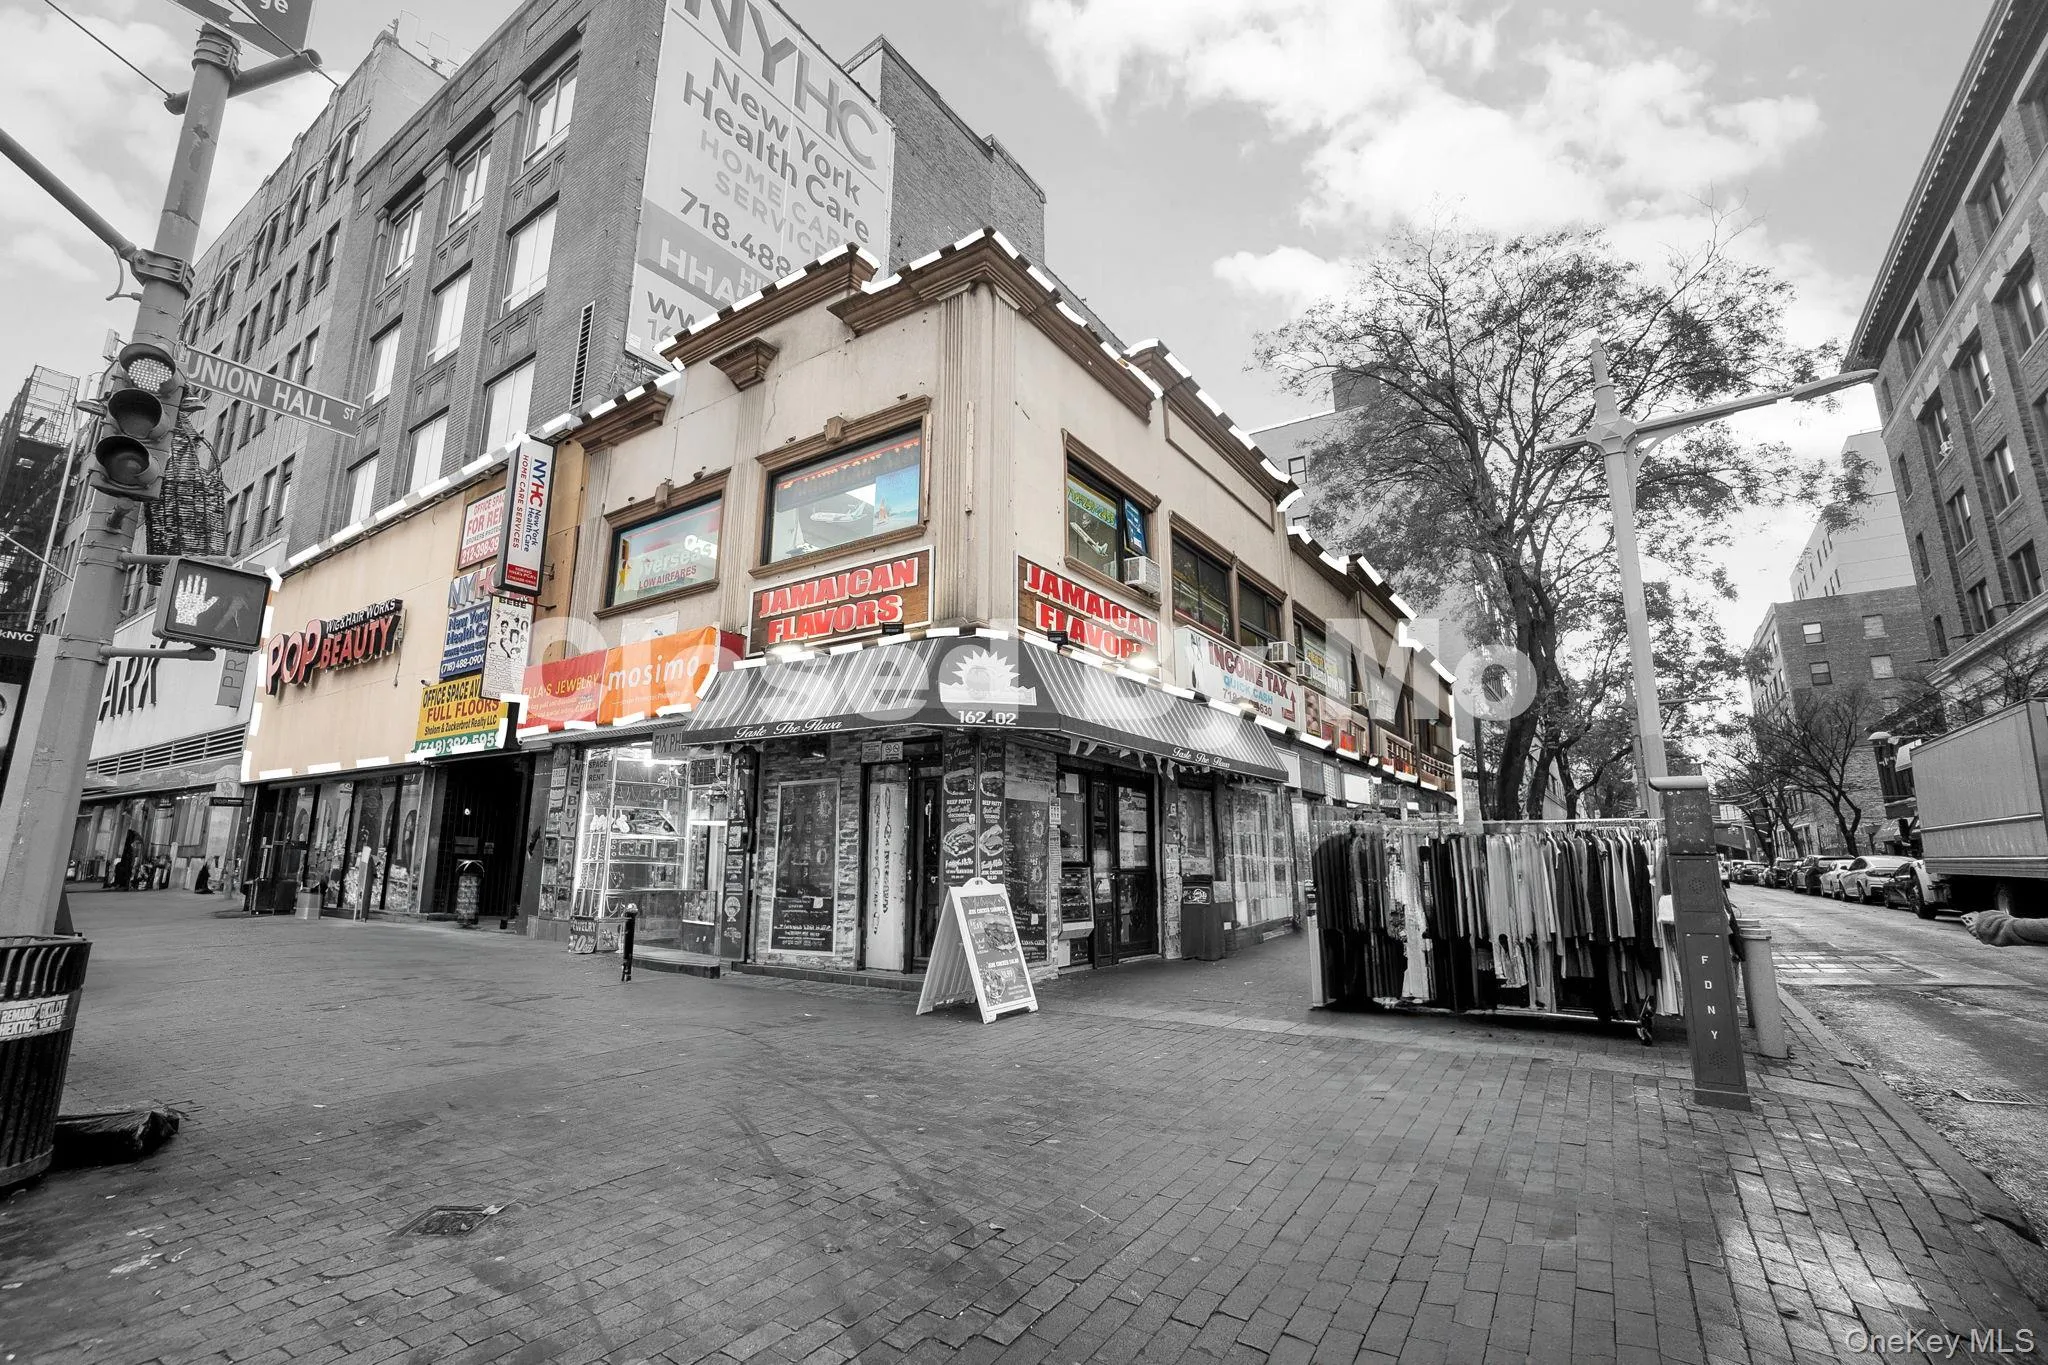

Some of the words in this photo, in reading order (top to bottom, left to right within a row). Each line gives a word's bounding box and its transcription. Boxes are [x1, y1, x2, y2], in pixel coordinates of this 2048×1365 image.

[712, 57, 789, 142] New
[796, 126, 861, 206] York
[683, 71, 797, 188] Health
[805, 174, 870, 243] Care
[700, 129, 782, 208] HOME
[791, 202, 853, 248] CAR
[187, 355, 263, 400] UNION
[271, 382, 332, 425] HALL
[343, 407, 356, 421] ST
[520, 454, 529, 479] HOME
[517, 481, 526, 505] CARE
[529, 459, 547, 507] NYHC
[467, 514, 485, 537] FOR
[512, 507, 523, 548] SERVICES
[526, 507, 534, 535] Health
[533, 509, 542, 528] New
[524, 535, 532, 552] Care
[531, 528, 541, 547] York
[759, 557, 919, 619] JAMAICAN
[366, 599, 396, 619] WORKS
[1024, 562, 1158, 646] JAMAICAN
[448, 616, 468, 632] New
[469, 606, 490, 622] York
[768, 595, 904, 645] FLAVORS
[1035, 600, 1147, 662] FLAVOR
[319, 615, 394, 670] BEAUTY
[446, 625, 475, 646] Health
[266, 619, 321, 694] POP
[1208, 641, 1264, 688] INCOME
[1265, 669, 1289, 699] TAX
[555, 672, 600, 695] JEWELRY
[608, 654, 700, 691] mosimo
[423, 687, 447, 709] OFFICE
[446, 680, 470, 704] SPACE
[1223, 674, 1251, 694] QUICK
[1253, 688, 1274, 705] CASH
[427, 704, 452, 724] FULL
[455, 699, 499, 719] FLOORS
[471, 716, 487, 729] Realty
[487, 714, 498, 726] LLC
[957, 710, 1017, 726] 162-02
[734, 725, 767, 739] Taste
[773, 721, 801, 735] The
[802, 718, 843, 732] Flava
[653, 733, 667, 754] FIX
[588, 760, 608, 768] SPACE
[588, 774, 605, 782] RENT
